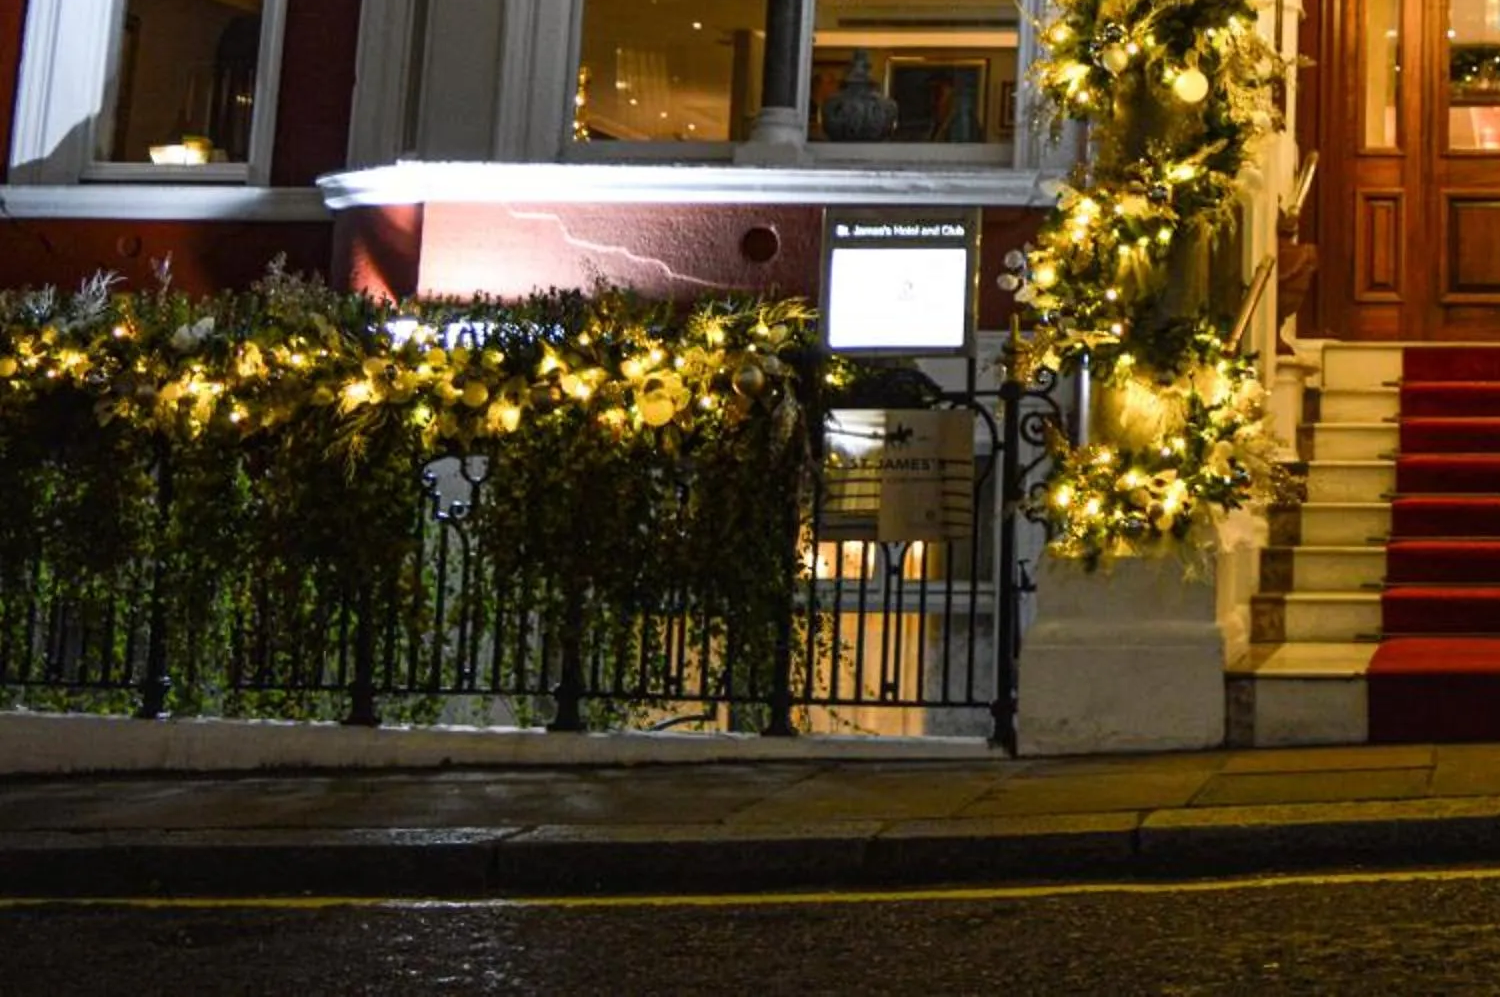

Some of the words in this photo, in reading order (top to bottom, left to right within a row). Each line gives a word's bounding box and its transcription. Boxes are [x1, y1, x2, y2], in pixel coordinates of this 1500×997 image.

[893, 224, 920, 236] Hotel
[921, 224, 941, 236] and
[941, 224, 965, 236] Club
